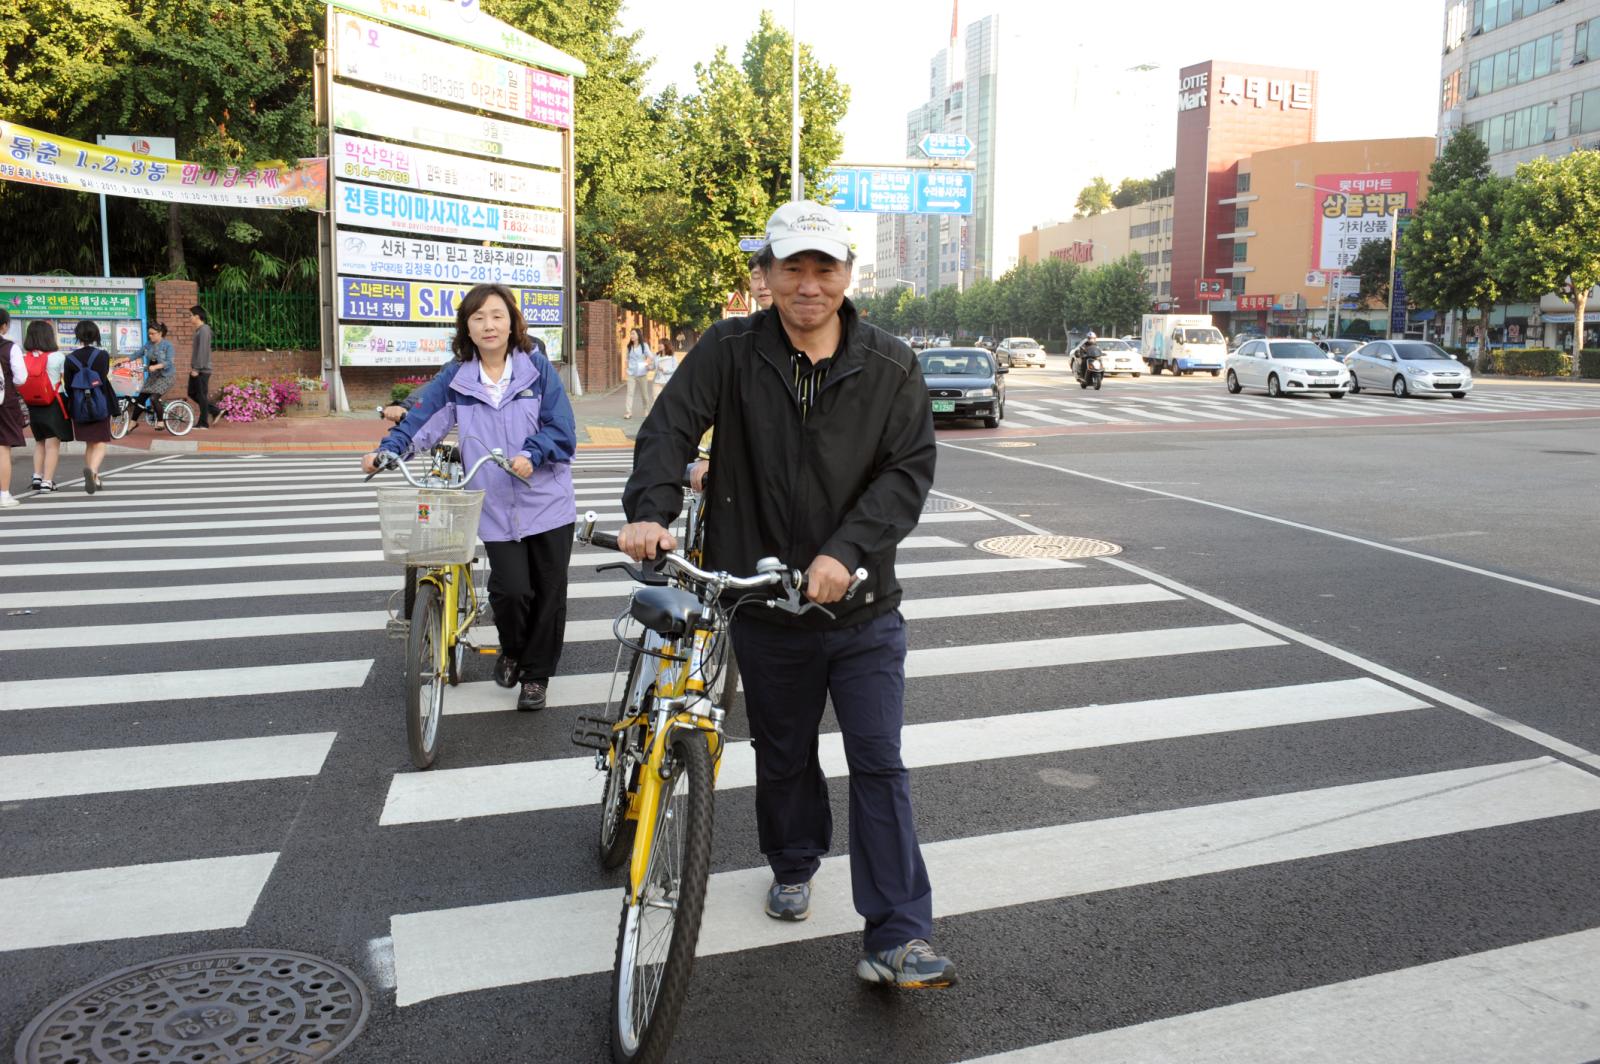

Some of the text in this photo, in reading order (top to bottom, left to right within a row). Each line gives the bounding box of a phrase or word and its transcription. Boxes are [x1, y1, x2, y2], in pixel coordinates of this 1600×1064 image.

[1179, 72, 1208, 91] LOTTE
[1177, 87, 1208, 112] Mart
[1220, 74, 1312, 111] 롯데마트
[9, 136, 60, 165] 동춘
[75, 150, 168, 182] 1.2.3동
[345, 142, 409, 170] 학산학원
[1339, 178, 1393, 192] 롯데마트
[344, 187, 500, 231] 전통타이마사지&스파
[1322, 192, 1408, 217] 상품혁명
[1339, 220, 1388, 233] 가치상품
[381, 239, 406, 258] 신차
[412, 243, 440, 261] 구입!
[473, 248, 533, 268] 전화주세요!!
[434, 263, 541, 283] 010-2813-4569
[348, 281, 405, 299] 스파르타식
[350, 301, 378, 317] 11년
[523, 308, 560, 322] 822-8252
[179, 958, 230, 972] MADE
